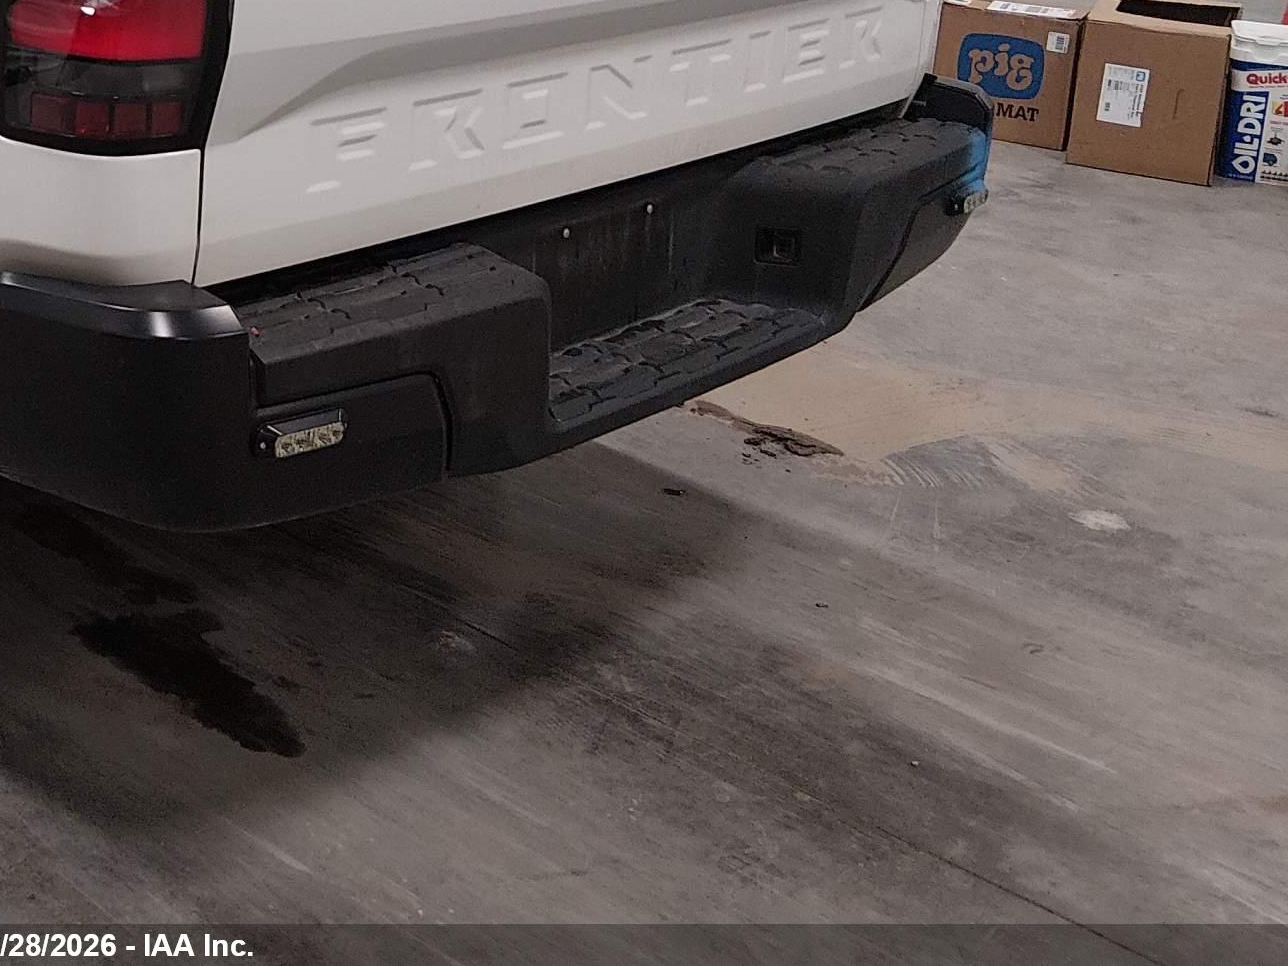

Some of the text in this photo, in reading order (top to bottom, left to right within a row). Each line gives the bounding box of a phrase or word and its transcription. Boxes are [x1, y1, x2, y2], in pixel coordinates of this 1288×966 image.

[967, 43, 1035, 91] pig
[306, 5, 884, 194] FRONTIER
[996, 102, 1039, 122] MAT
